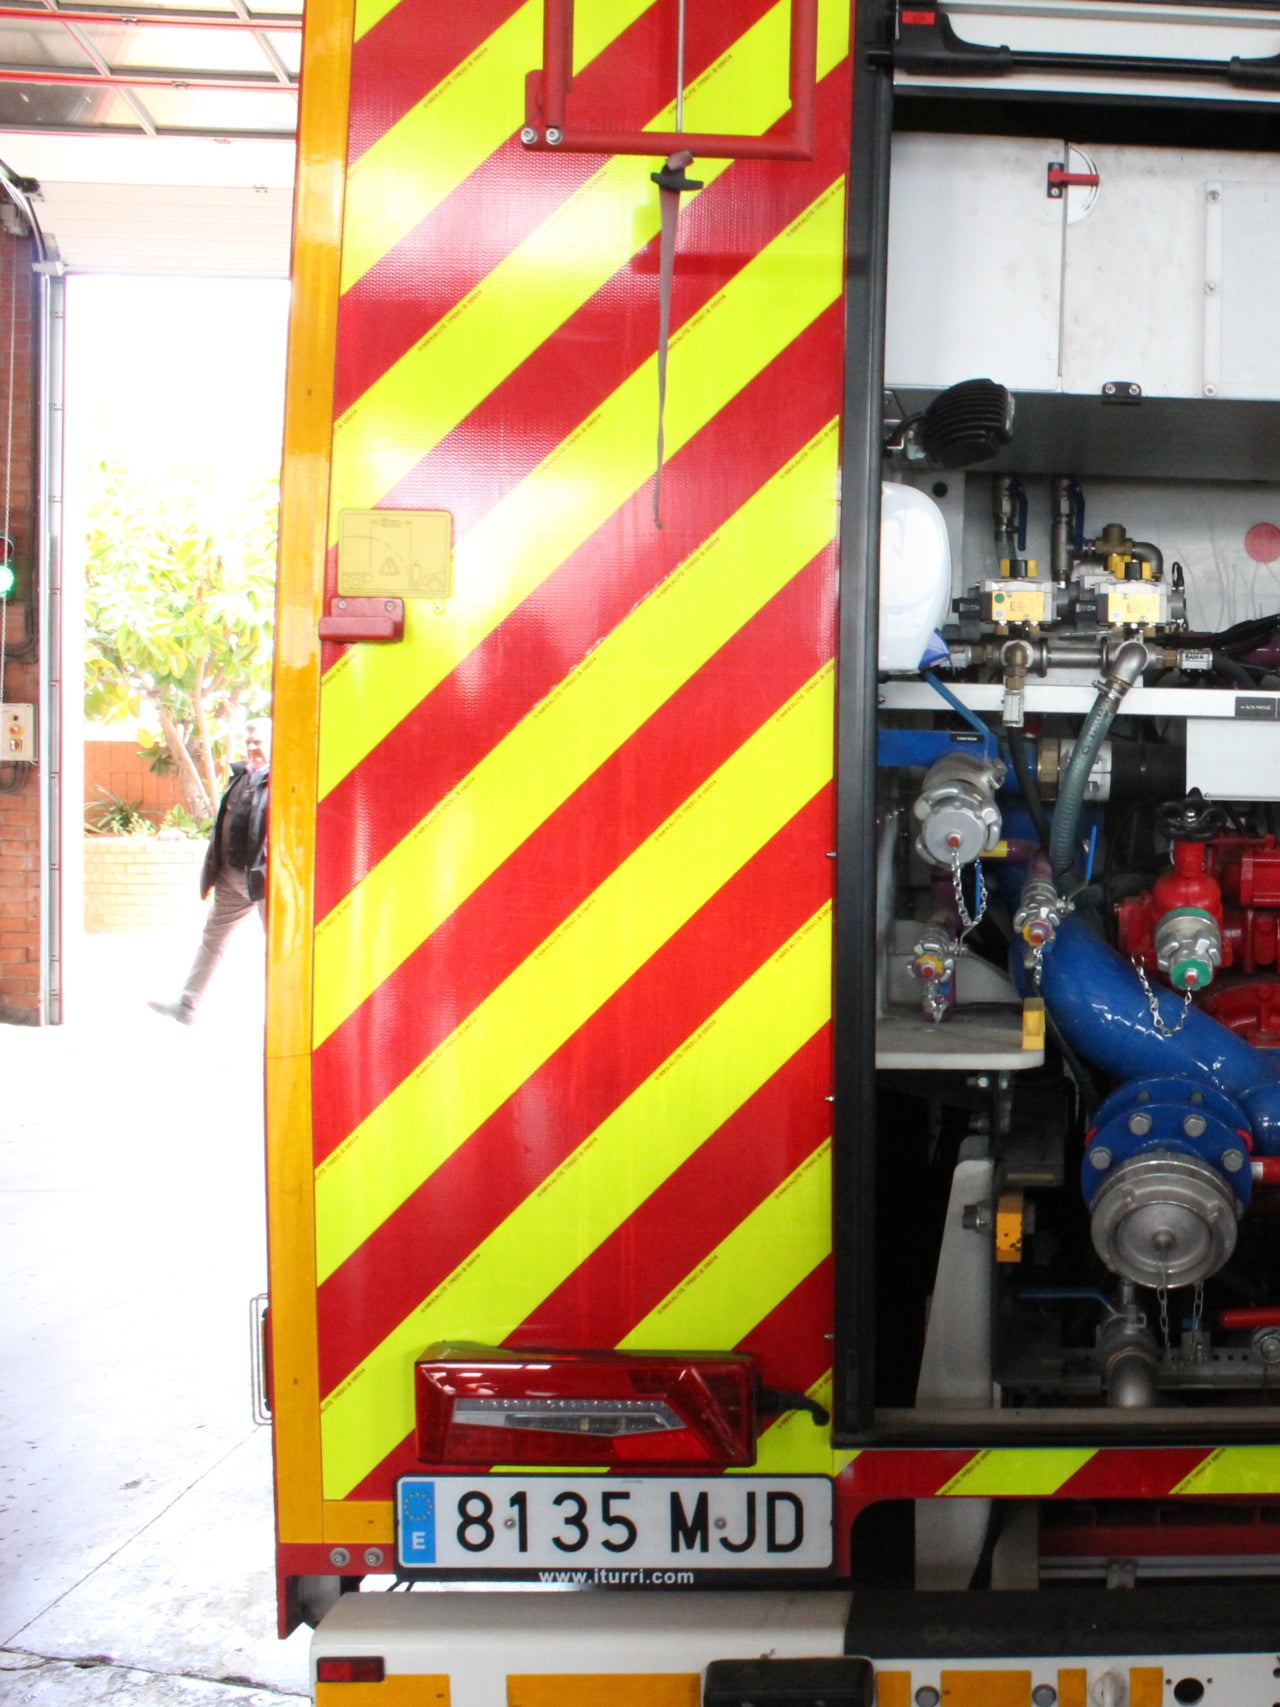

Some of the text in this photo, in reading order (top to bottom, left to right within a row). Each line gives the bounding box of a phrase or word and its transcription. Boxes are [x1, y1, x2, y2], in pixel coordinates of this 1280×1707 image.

[456, 1490, 804, 1553] 8135 MJD
[412, 1531, 426, 1550] E
[538, 1568, 695, 1585] www.iturri.com
